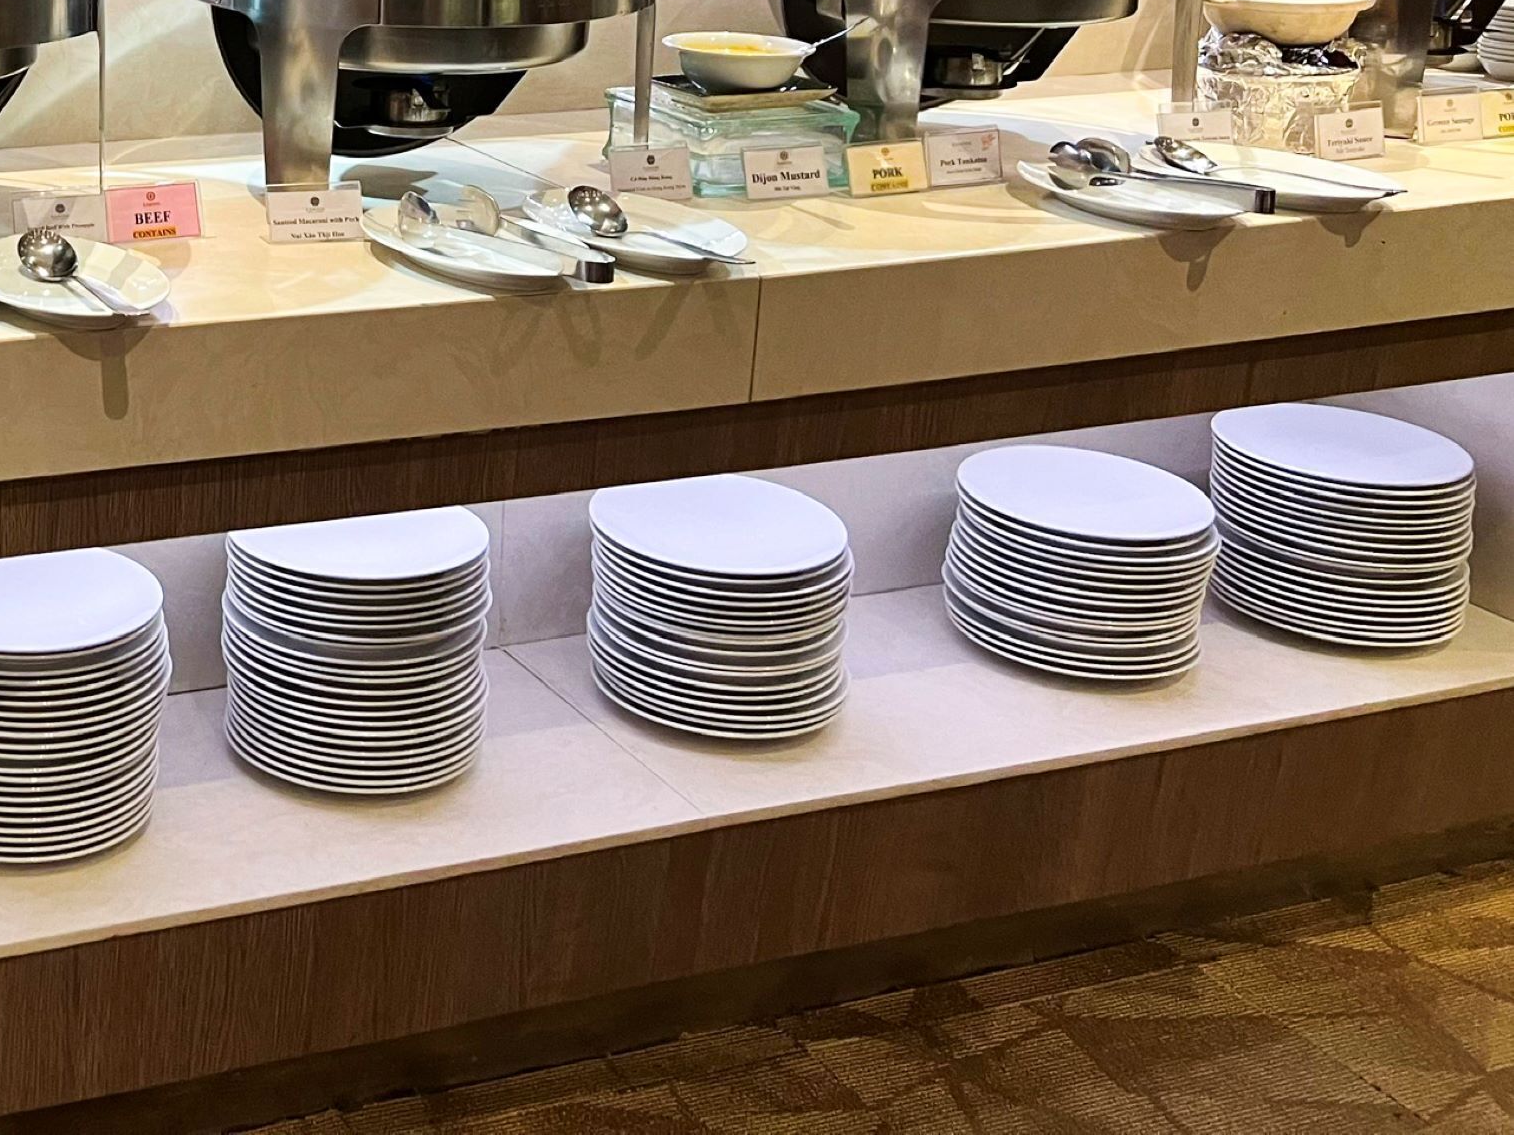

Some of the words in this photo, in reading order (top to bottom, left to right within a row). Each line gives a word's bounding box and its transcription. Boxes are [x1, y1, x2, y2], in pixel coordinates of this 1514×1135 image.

[751, 172, 778, 185] Dijon
[780, 168, 820, 181] Mustard
[872, 166, 903, 180] PORK
[134, 210, 171, 225] BEEF
[132, 228, 176, 239] CONTAINS
